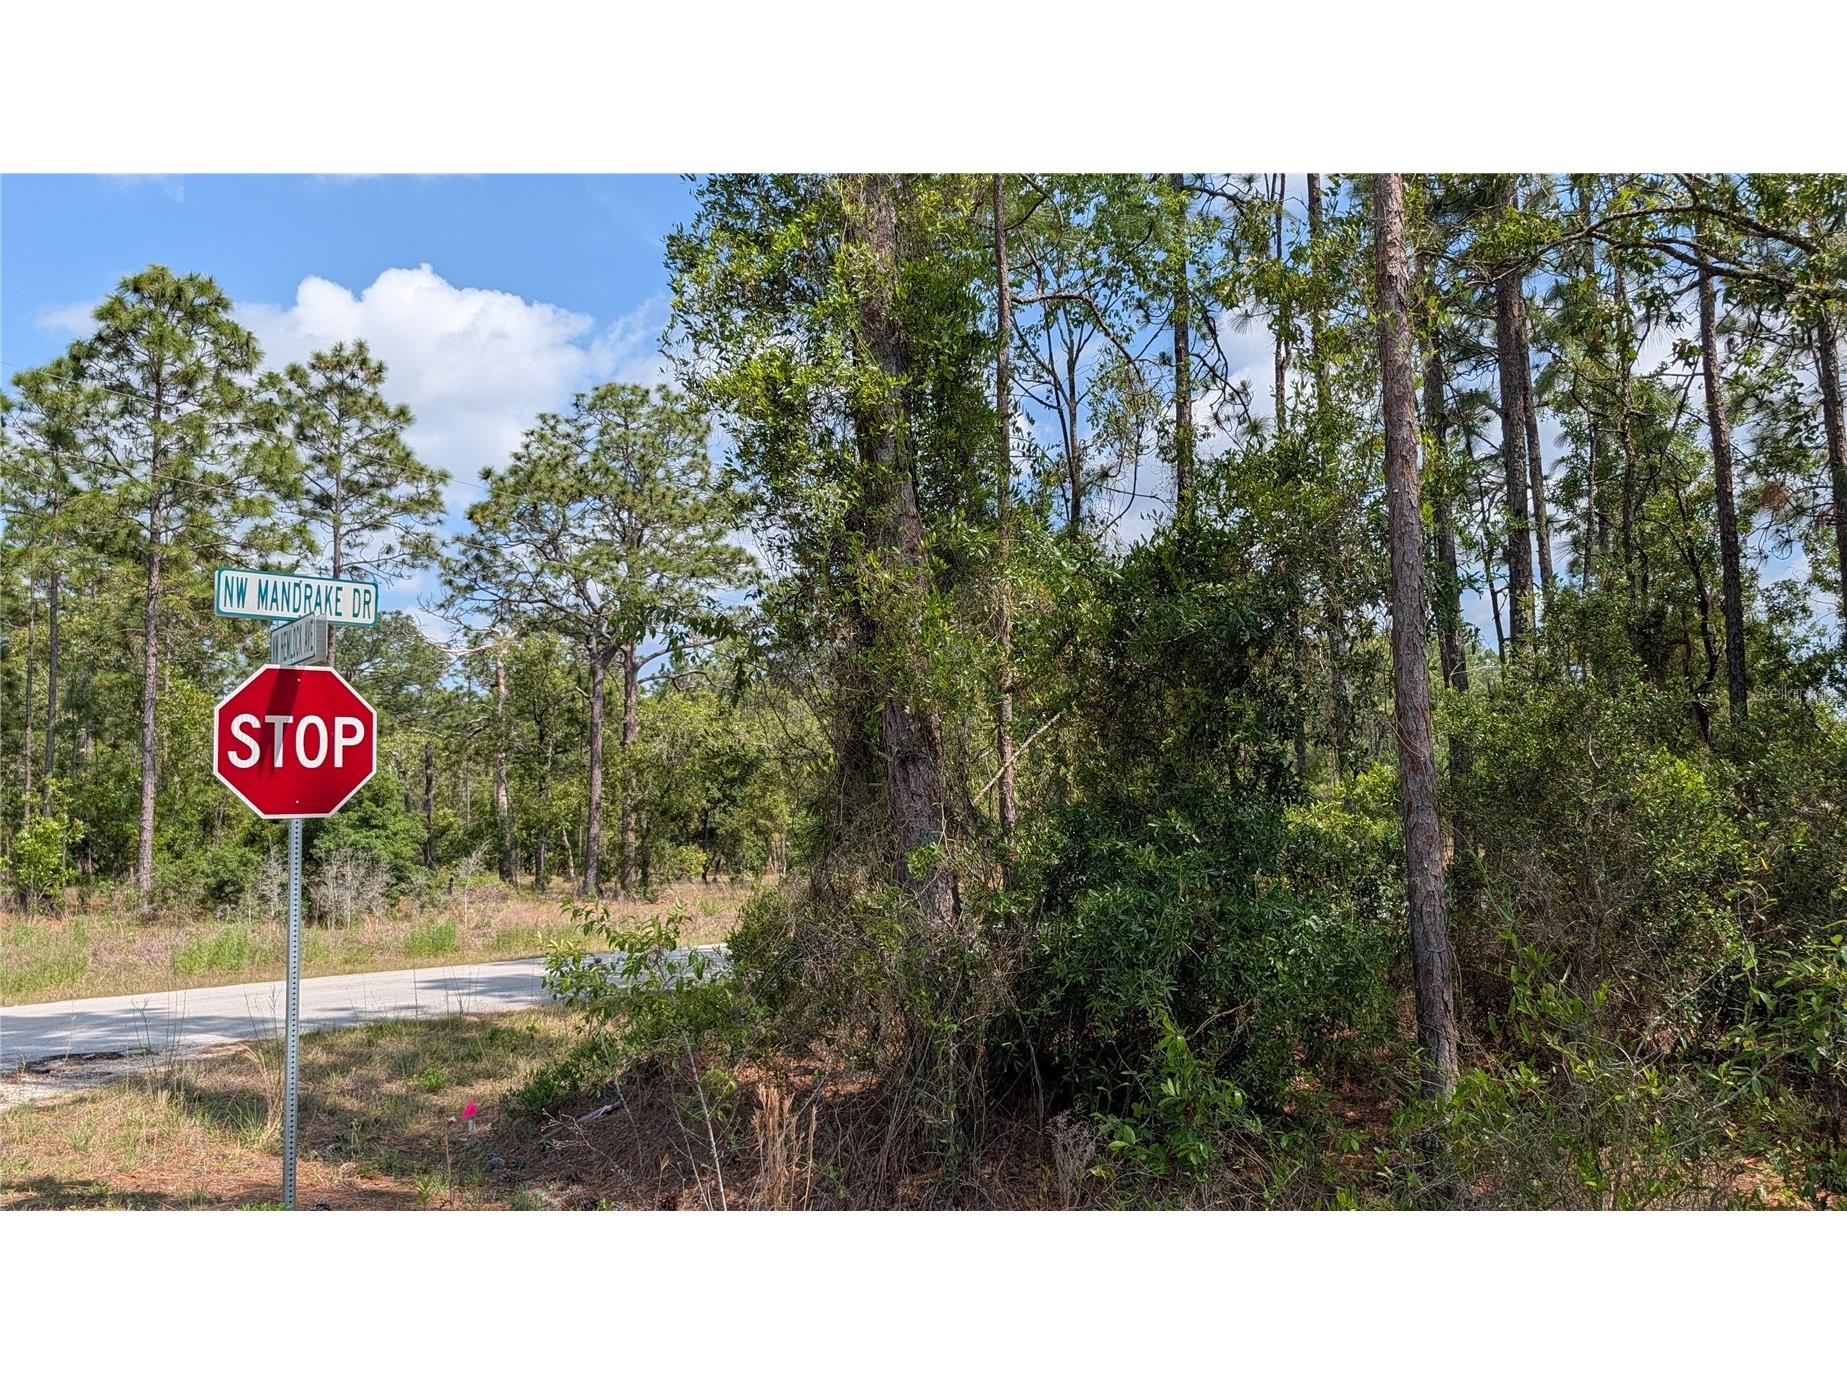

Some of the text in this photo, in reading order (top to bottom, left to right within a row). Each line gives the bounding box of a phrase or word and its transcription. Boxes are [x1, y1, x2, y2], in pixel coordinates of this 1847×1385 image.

[224, 575, 372, 620] NW MANDRAKE DR
[227, 713, 365, 769] STOP
